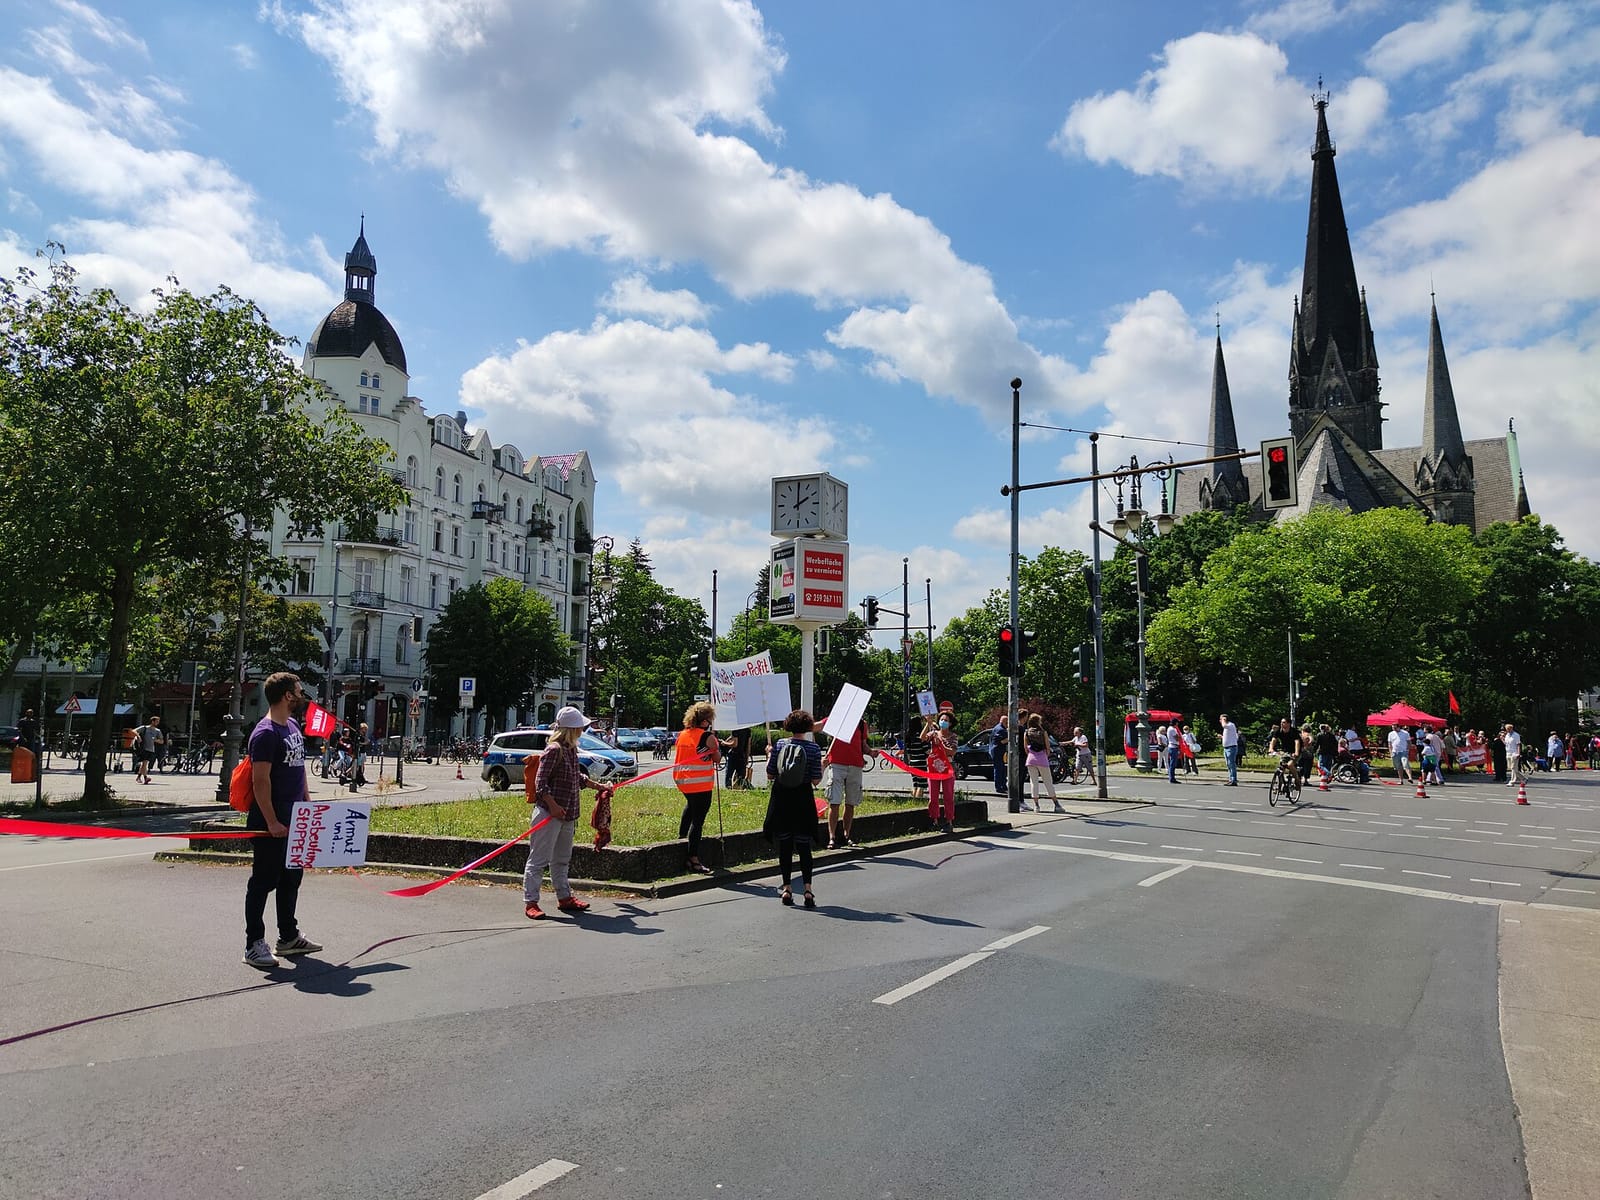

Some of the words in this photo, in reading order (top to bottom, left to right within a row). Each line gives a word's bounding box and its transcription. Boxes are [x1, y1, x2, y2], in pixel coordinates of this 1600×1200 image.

[806, 556, 842, 566] Werbefläche
[814, 567, 842, 575] vermieten
[344, 809, 368, 855] Armut
